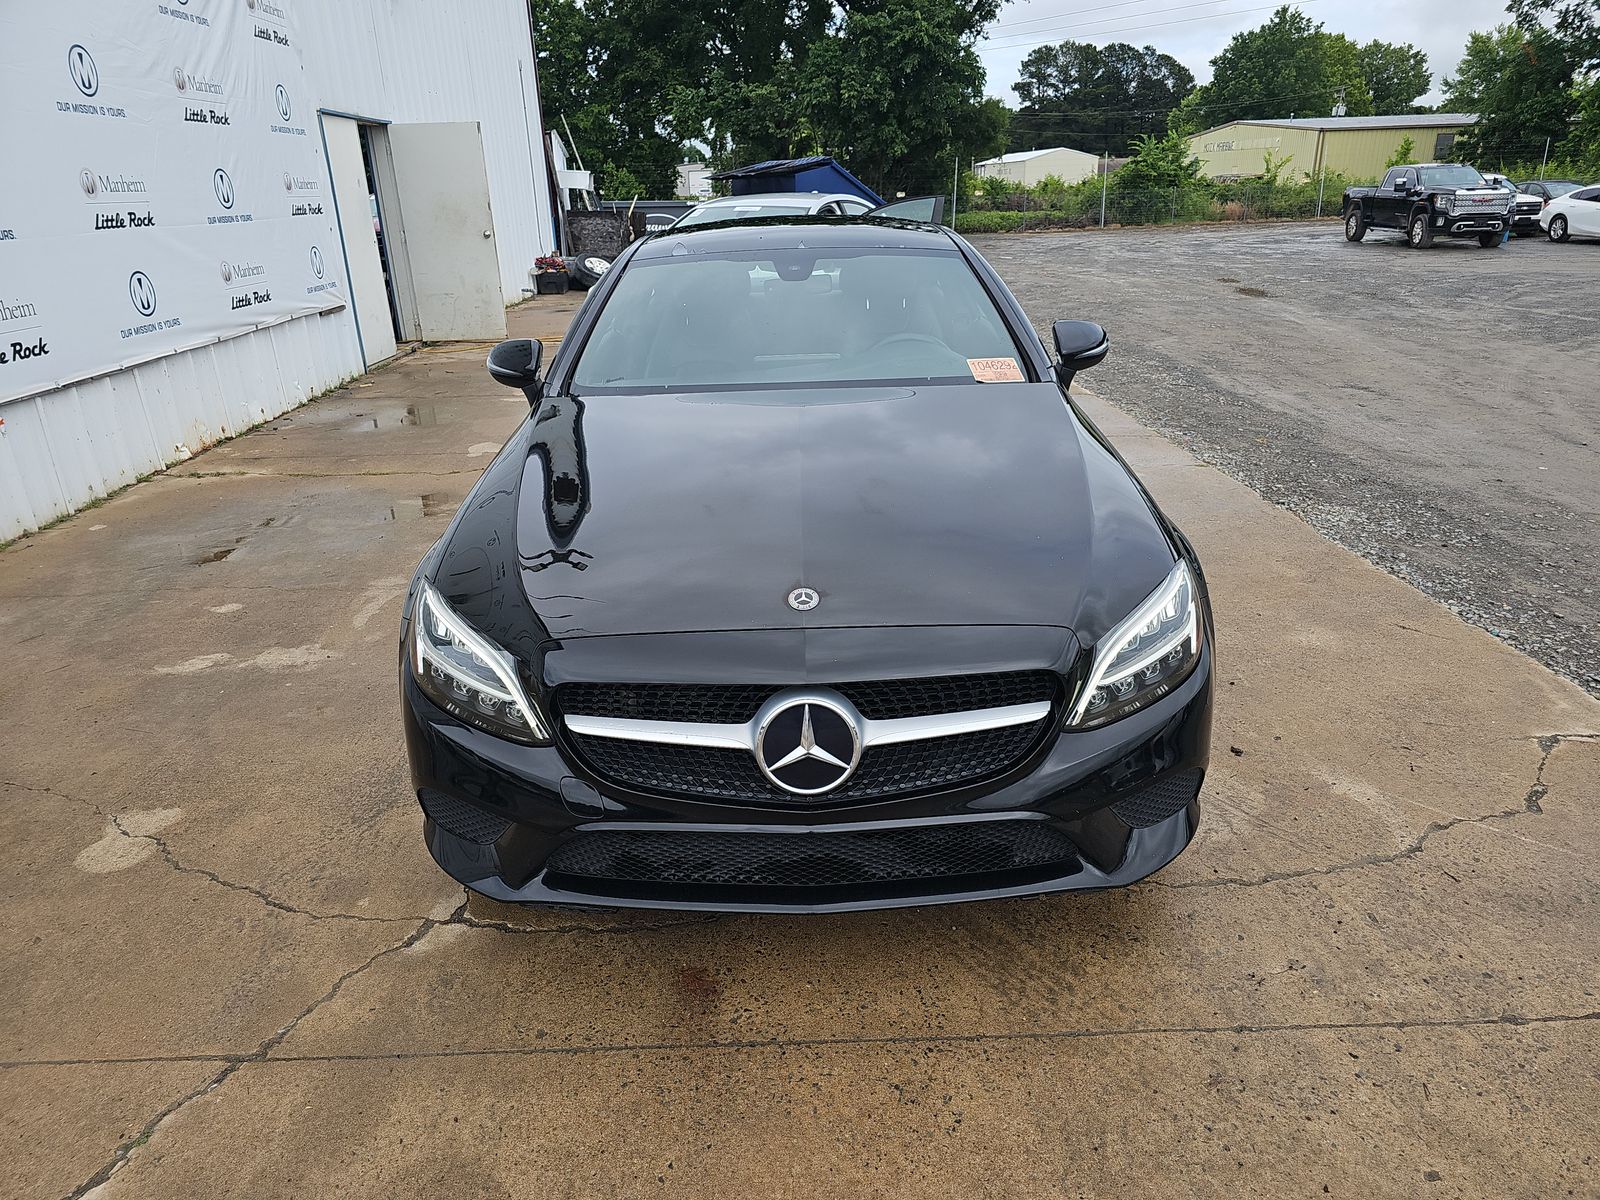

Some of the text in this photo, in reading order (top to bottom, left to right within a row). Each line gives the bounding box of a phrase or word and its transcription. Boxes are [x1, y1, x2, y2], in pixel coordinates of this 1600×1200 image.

[254, 24, 290, 47] Little Rock
[187, 74, 223, 95] Manheim
[56, 101, 71, 112] OUR
[71, 103, 98, 115] MISSION
[99, 106, 105, 117] IS
[184, 106, 230, 125] Little Rock
[98, 174, 147, 193] Manheim
[292, 176, 319, 190] Manheim
[291, 203, 324, 216] Little Rock
[94, 210, 156, 230] Little Rock
[0, 229, 16, 240] URS.
[232, 262, 265, 280] Manheim
[231, 289, 272, 310] Little Rock
[120, 328, 133, 339] OUR
[133, 323, 157, 336] MISSION
[157, 321, 163, 330] IS
[10, 337, 50, 362] Rock
